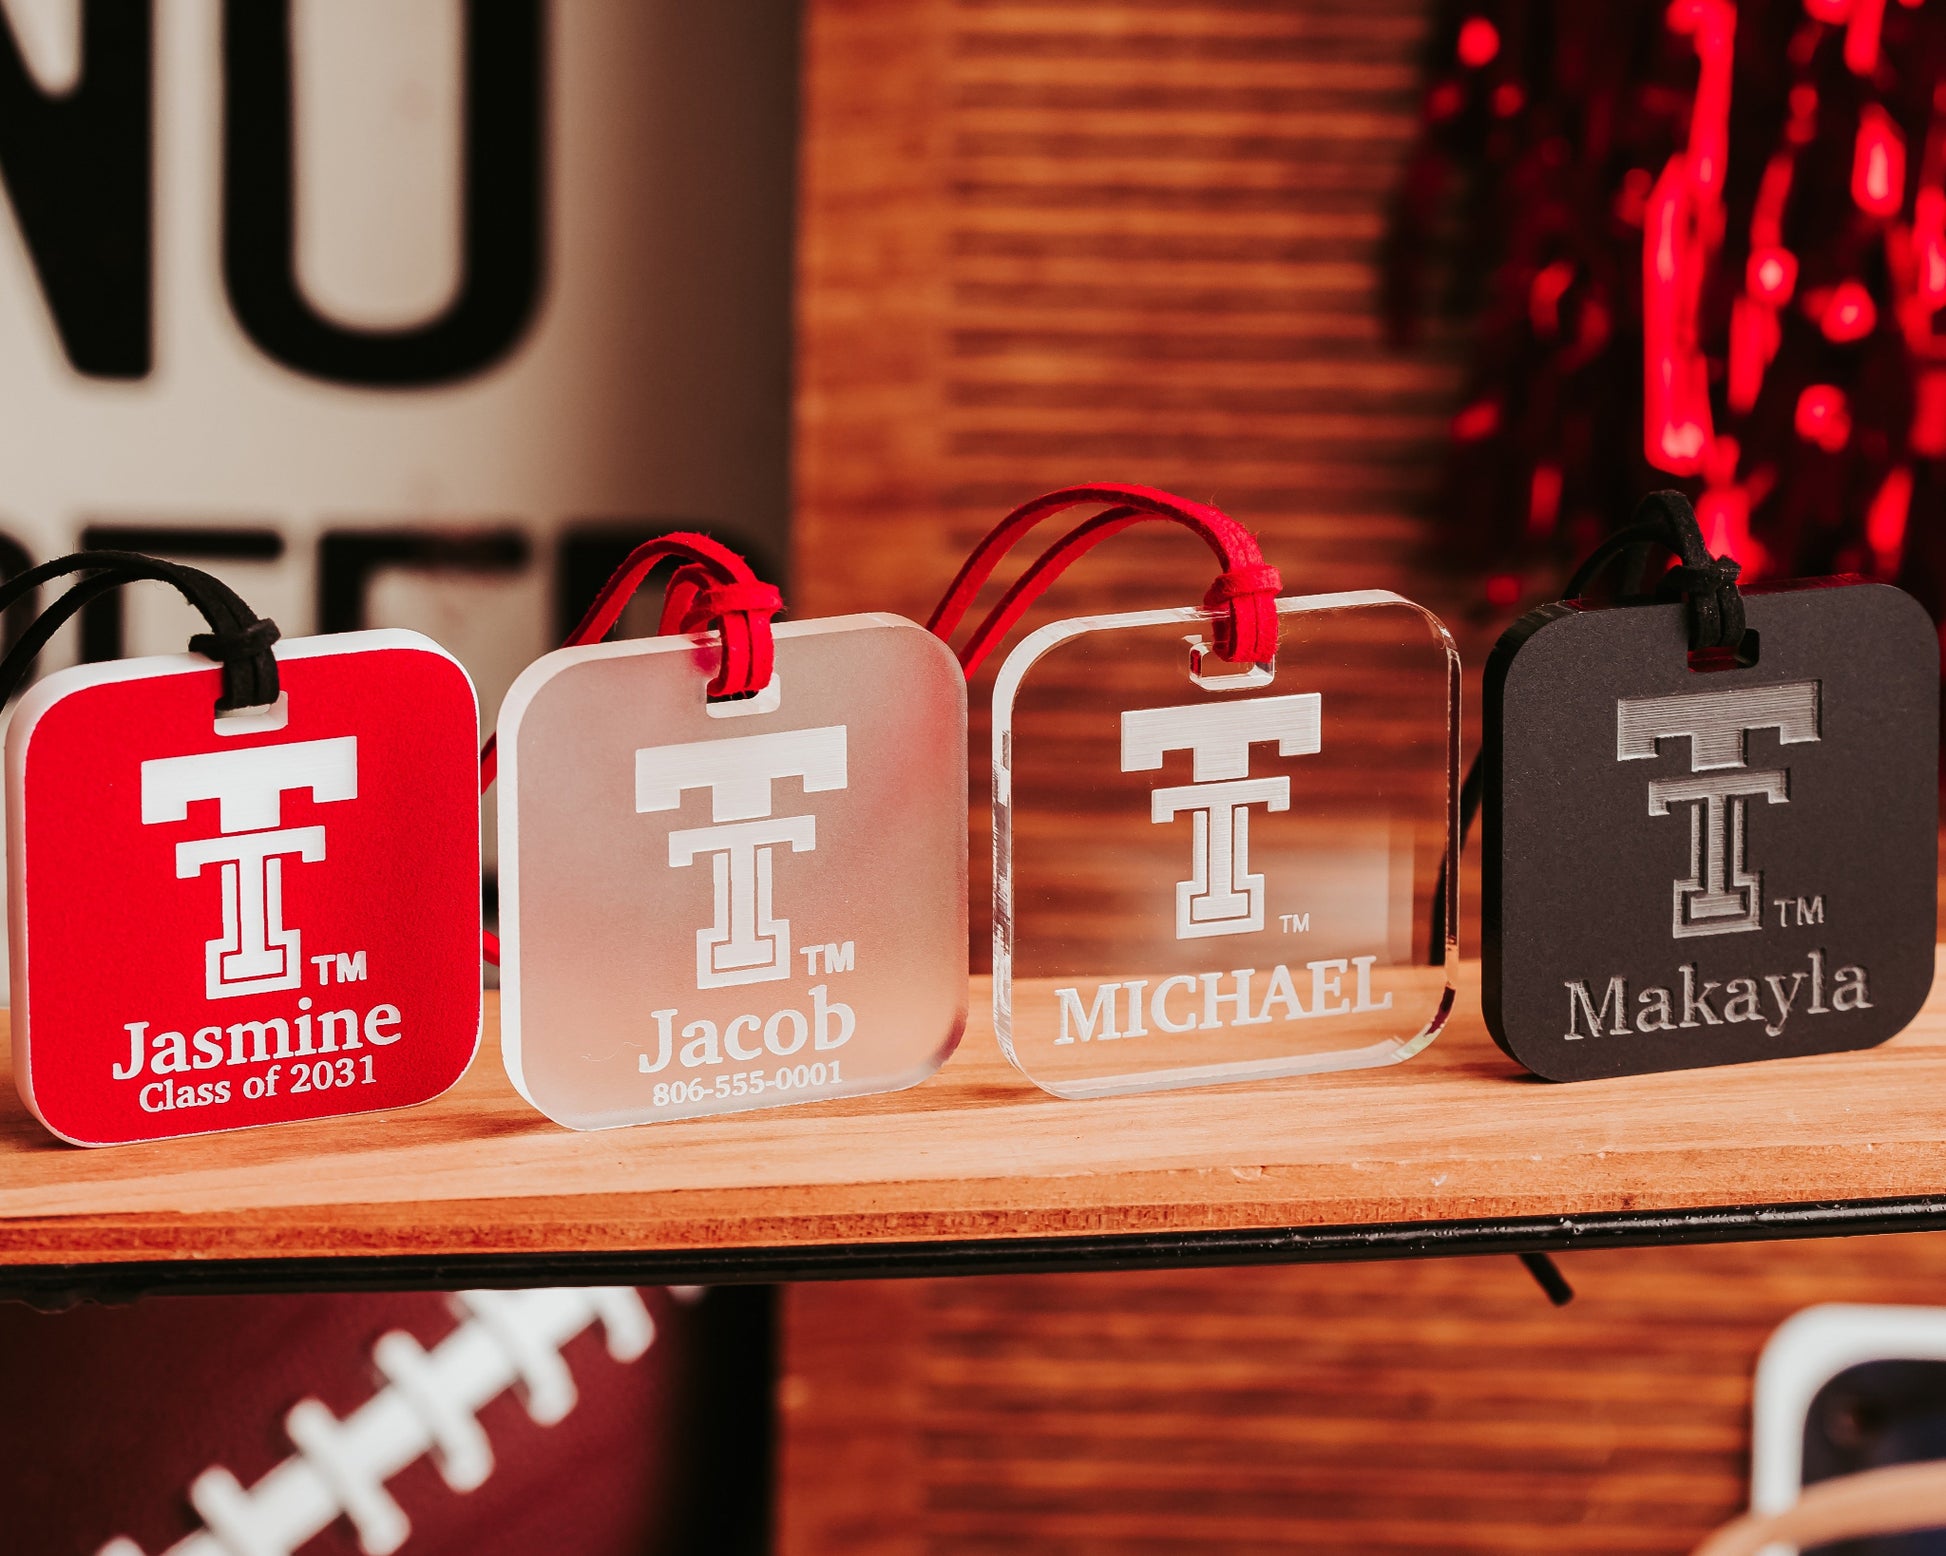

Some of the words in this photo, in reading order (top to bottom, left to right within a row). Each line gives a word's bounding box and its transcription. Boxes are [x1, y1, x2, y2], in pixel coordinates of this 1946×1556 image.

[1279, 913, 1309, 933] TM
[1774, 896, 1825, 926] TM
[311, 951, 367, 985] TM
[800, 941, 855, 975] TM
[1053, 955, 1393, 1045] MICHAEL
[1564, 948, 1873, 1041] Makayla
[112, 998, 401, 1080] Jasmine
[639, 984, 855, 1073] Jacob
[139, 1076, 231, 1113] Class
[243, 1066, 281, 1098] of
[290, 1055, 376, 1092] 2031
[652, 1060, 842, 1106] 806-555-0001
